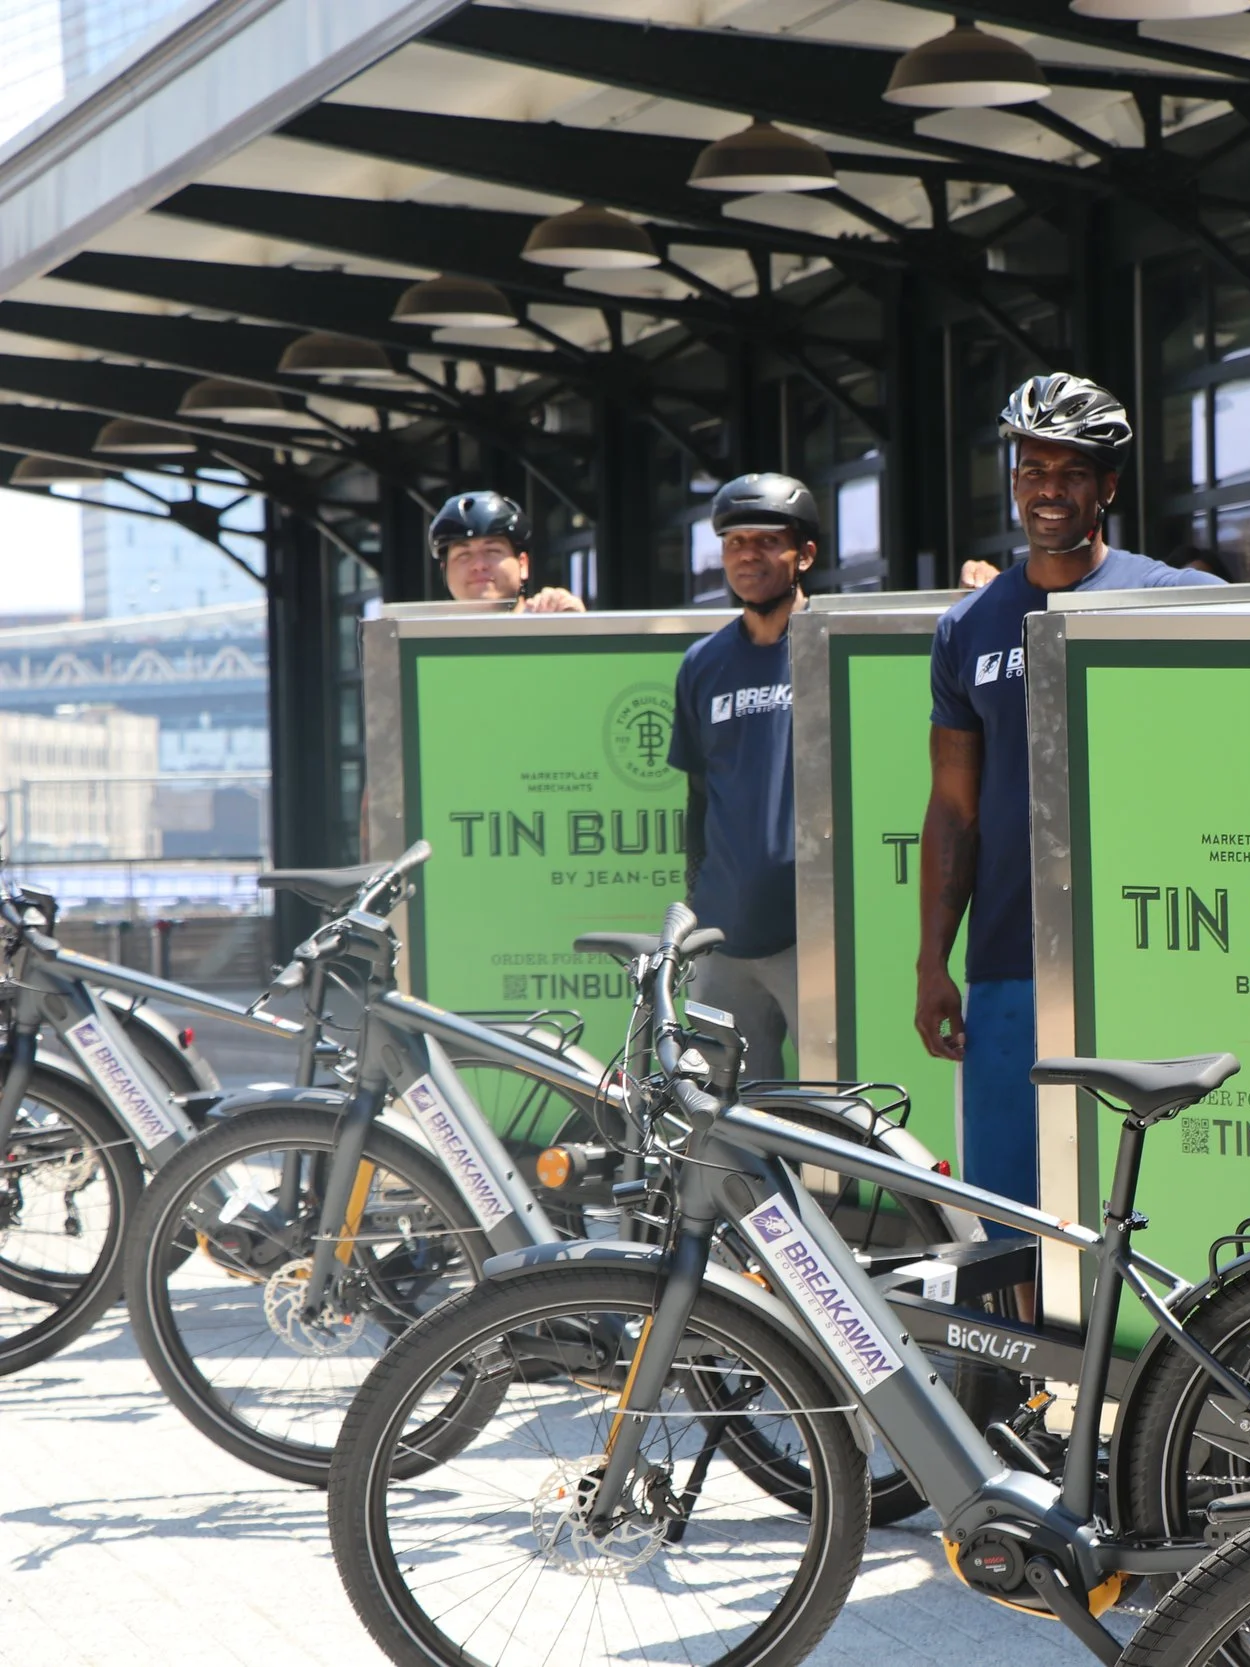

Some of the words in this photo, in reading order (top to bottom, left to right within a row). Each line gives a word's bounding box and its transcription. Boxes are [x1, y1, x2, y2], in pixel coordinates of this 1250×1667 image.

[520, 771, 600, 781] MARKETPLACE
[527, 784, 593, 793] MERCHANTS
[449, 810, 546, 857] TIN
[551, 871, 578, 885] BY
[584, 870, 687, 888] JEAN-GE
[1122, 886, 1229, 953] TIN
[491, 953, 550, 966] ORDER
[552, 953, 585, 965] FOR
[95, 1047, 169, 1136] BREAKAWAY
[431, 1112, 505, 1217] BREAKAWAY
[774, 1251, 824, 1316] COURIER
[825, 1320, 877, 1387] SYSTEMS
[783, 1240, 894, 1374] BREAKAWAY
